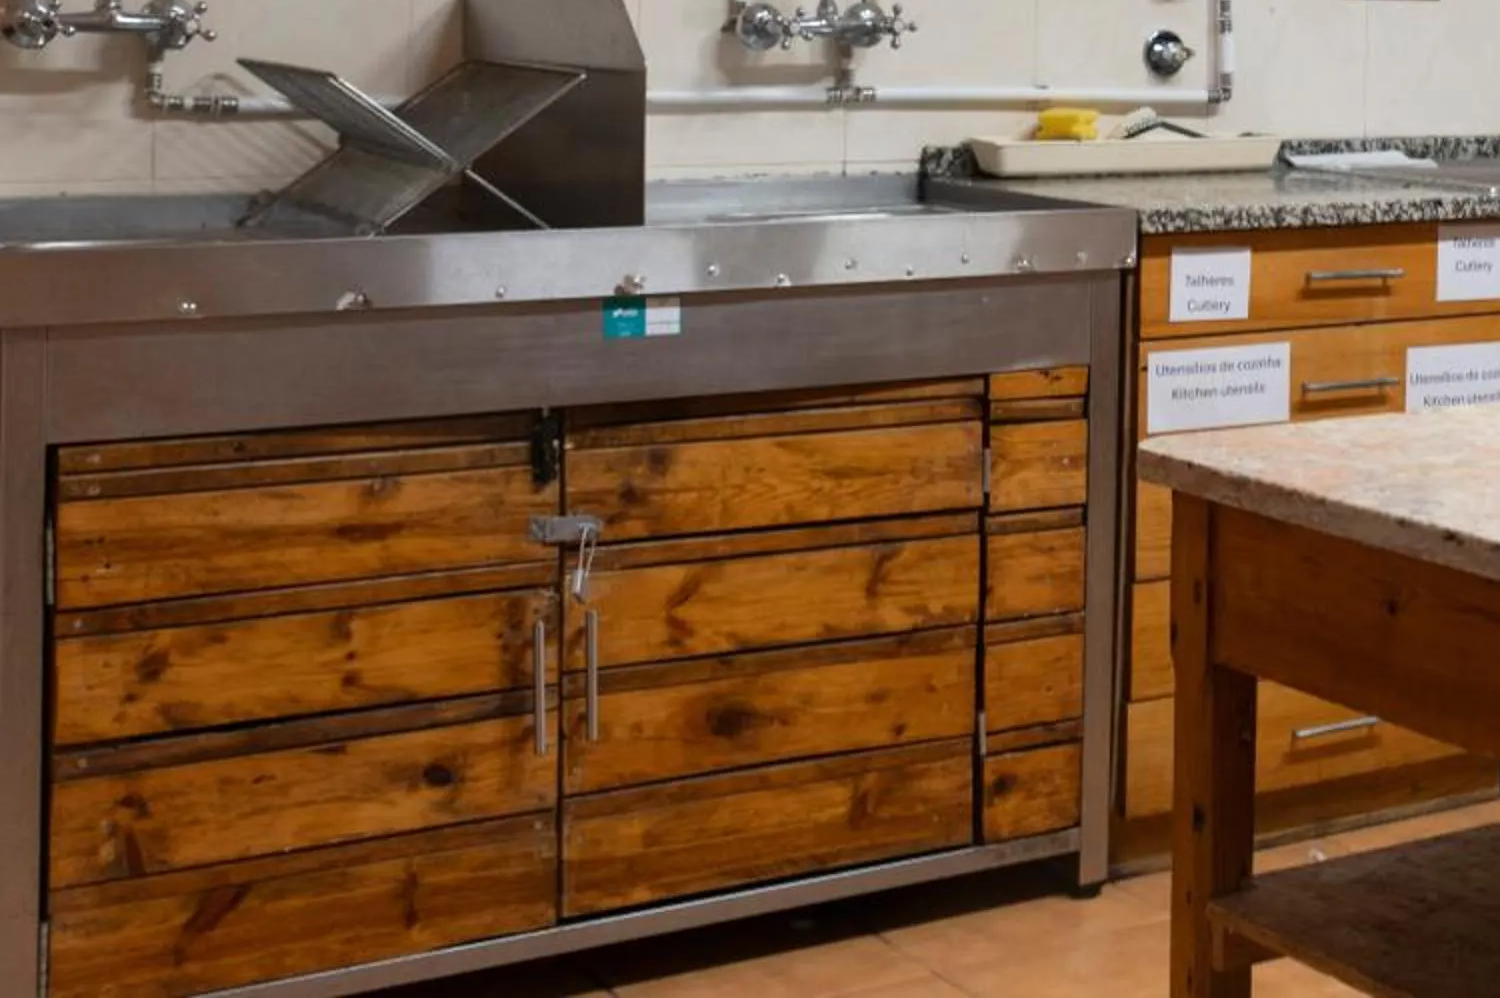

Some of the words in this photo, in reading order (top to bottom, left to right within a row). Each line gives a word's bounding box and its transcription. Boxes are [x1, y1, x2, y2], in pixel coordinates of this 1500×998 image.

[1454, 259, 1494, 274] Cutlery
[1187, 298, 1232, 314] Cutlery
[1219, 358, 1235, 372] de
[1236, 356, 1282, 371] cozinha
[1465, 369, 1480, 382] de
[1171, 384, 1219, 400] Kitchen
[1221, 382, 1266, 397] utensils
[1422, 393, 1466, 408] Kitchen
